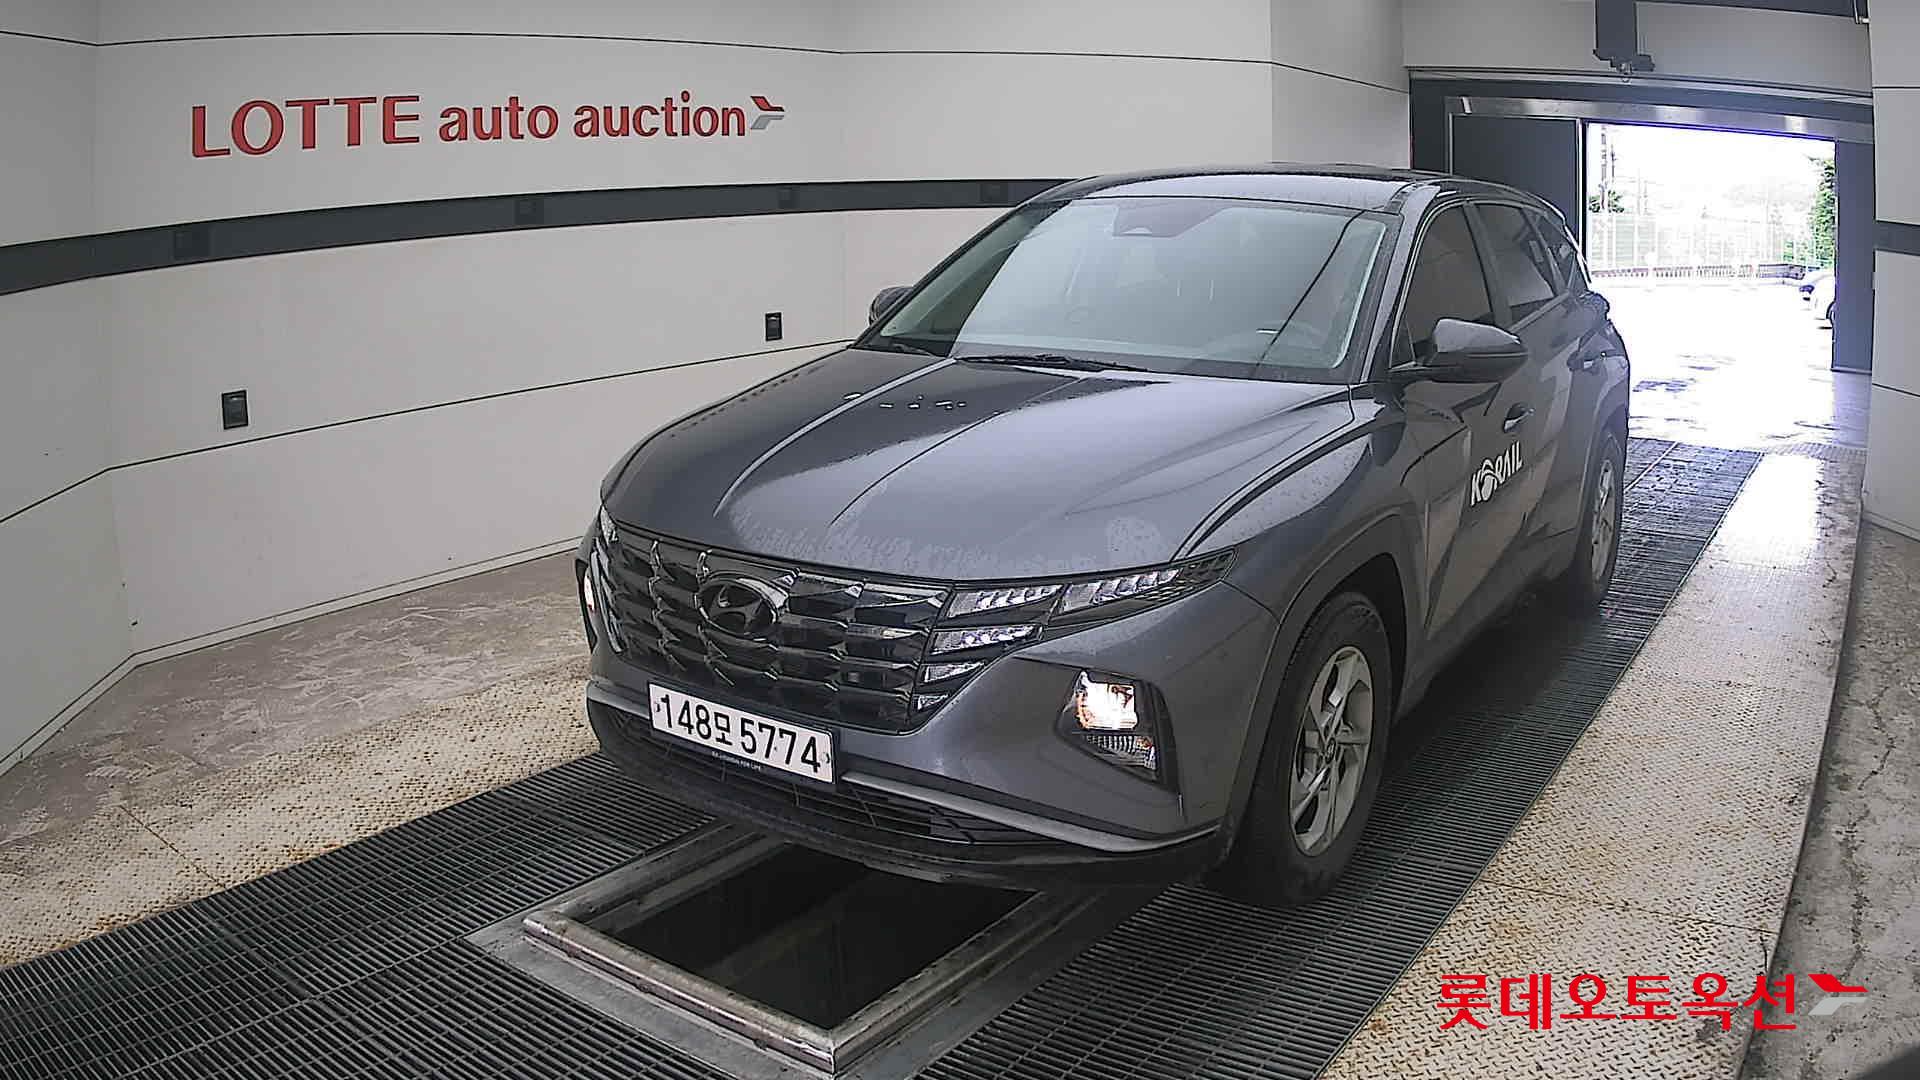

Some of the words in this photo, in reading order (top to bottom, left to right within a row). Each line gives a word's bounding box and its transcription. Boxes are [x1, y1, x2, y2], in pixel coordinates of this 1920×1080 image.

[192, 95, 420, 158] LOTTE
[438, 97, 559, 142] auto
[573, 91, 746, 138] auction
[1471, 441, 1523, 506] KORAIL
[661, 694, 733, 746] 148모
[740, 718, 822, 773] 5774
